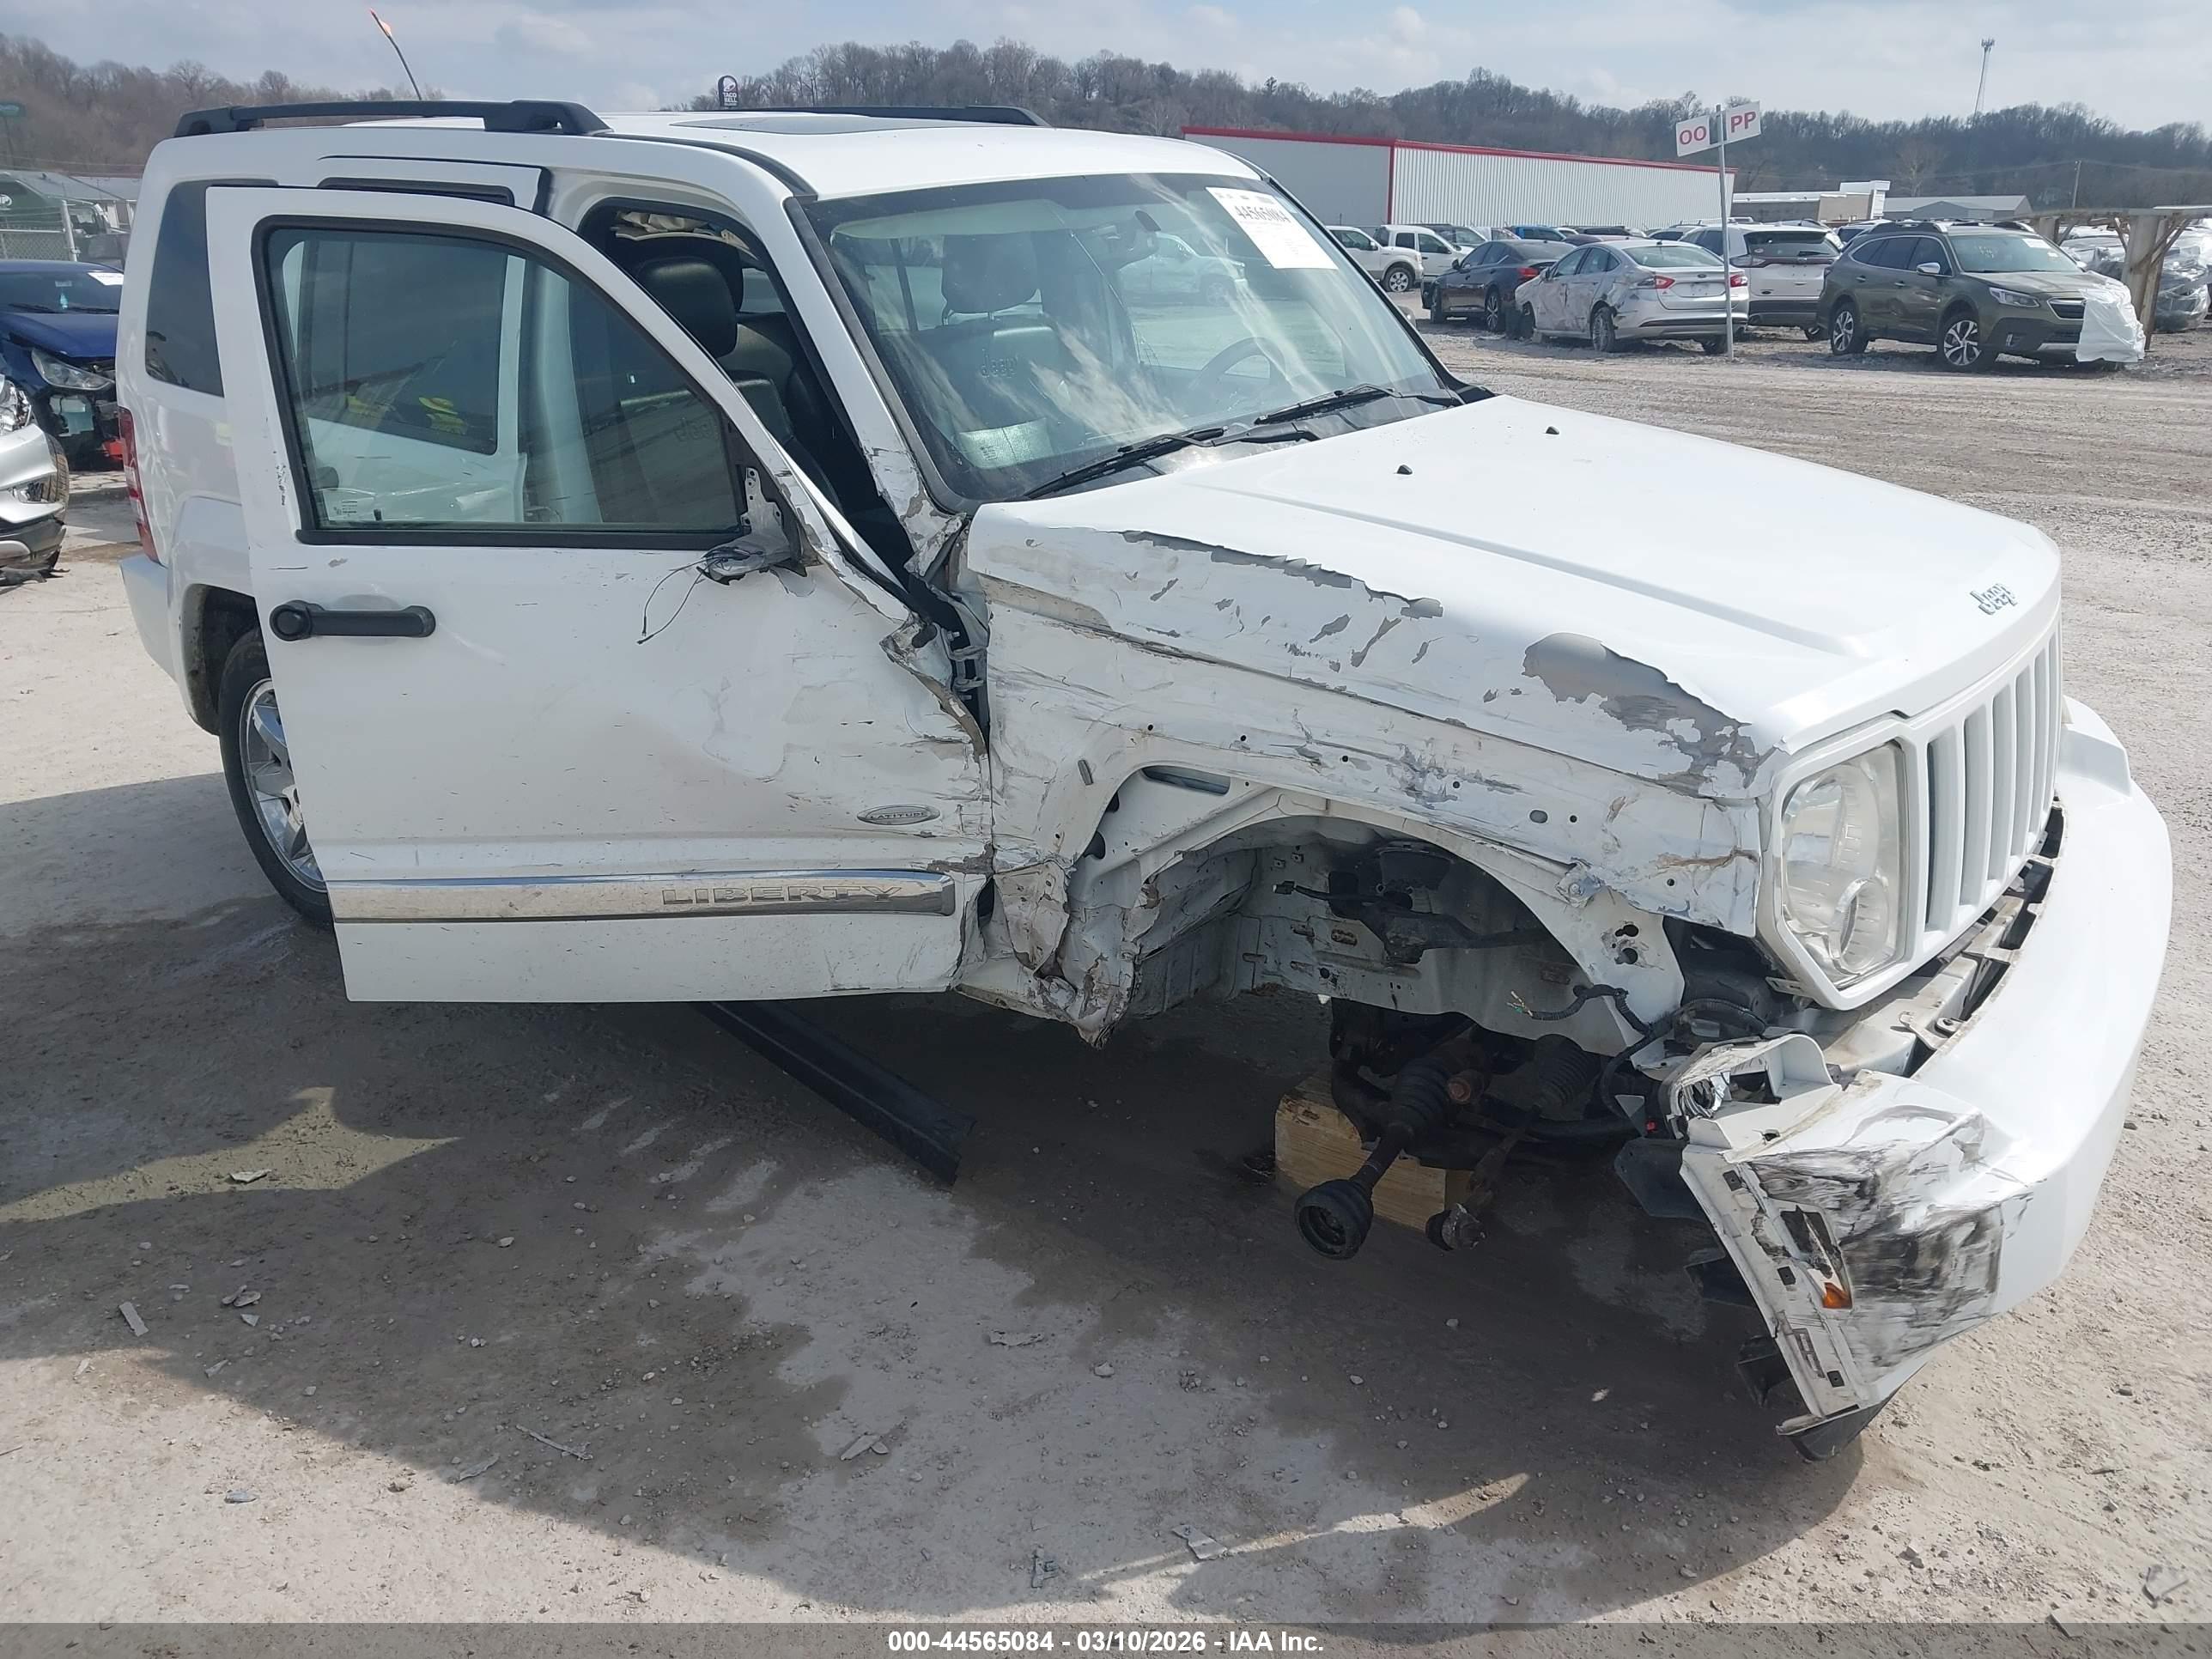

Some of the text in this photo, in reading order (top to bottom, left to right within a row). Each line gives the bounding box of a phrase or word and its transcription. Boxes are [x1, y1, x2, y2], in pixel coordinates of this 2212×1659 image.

[1730, 111, 1757, 133] PP
[1679, 125, 1707, 145] OO
[1234, 205, 1291, 223] 44565084
[1969, 583, 2018, 616] Jeep
[869, 810, 928, 820] LATITUDE
[662, 885, 902, 905] LIBERTY
